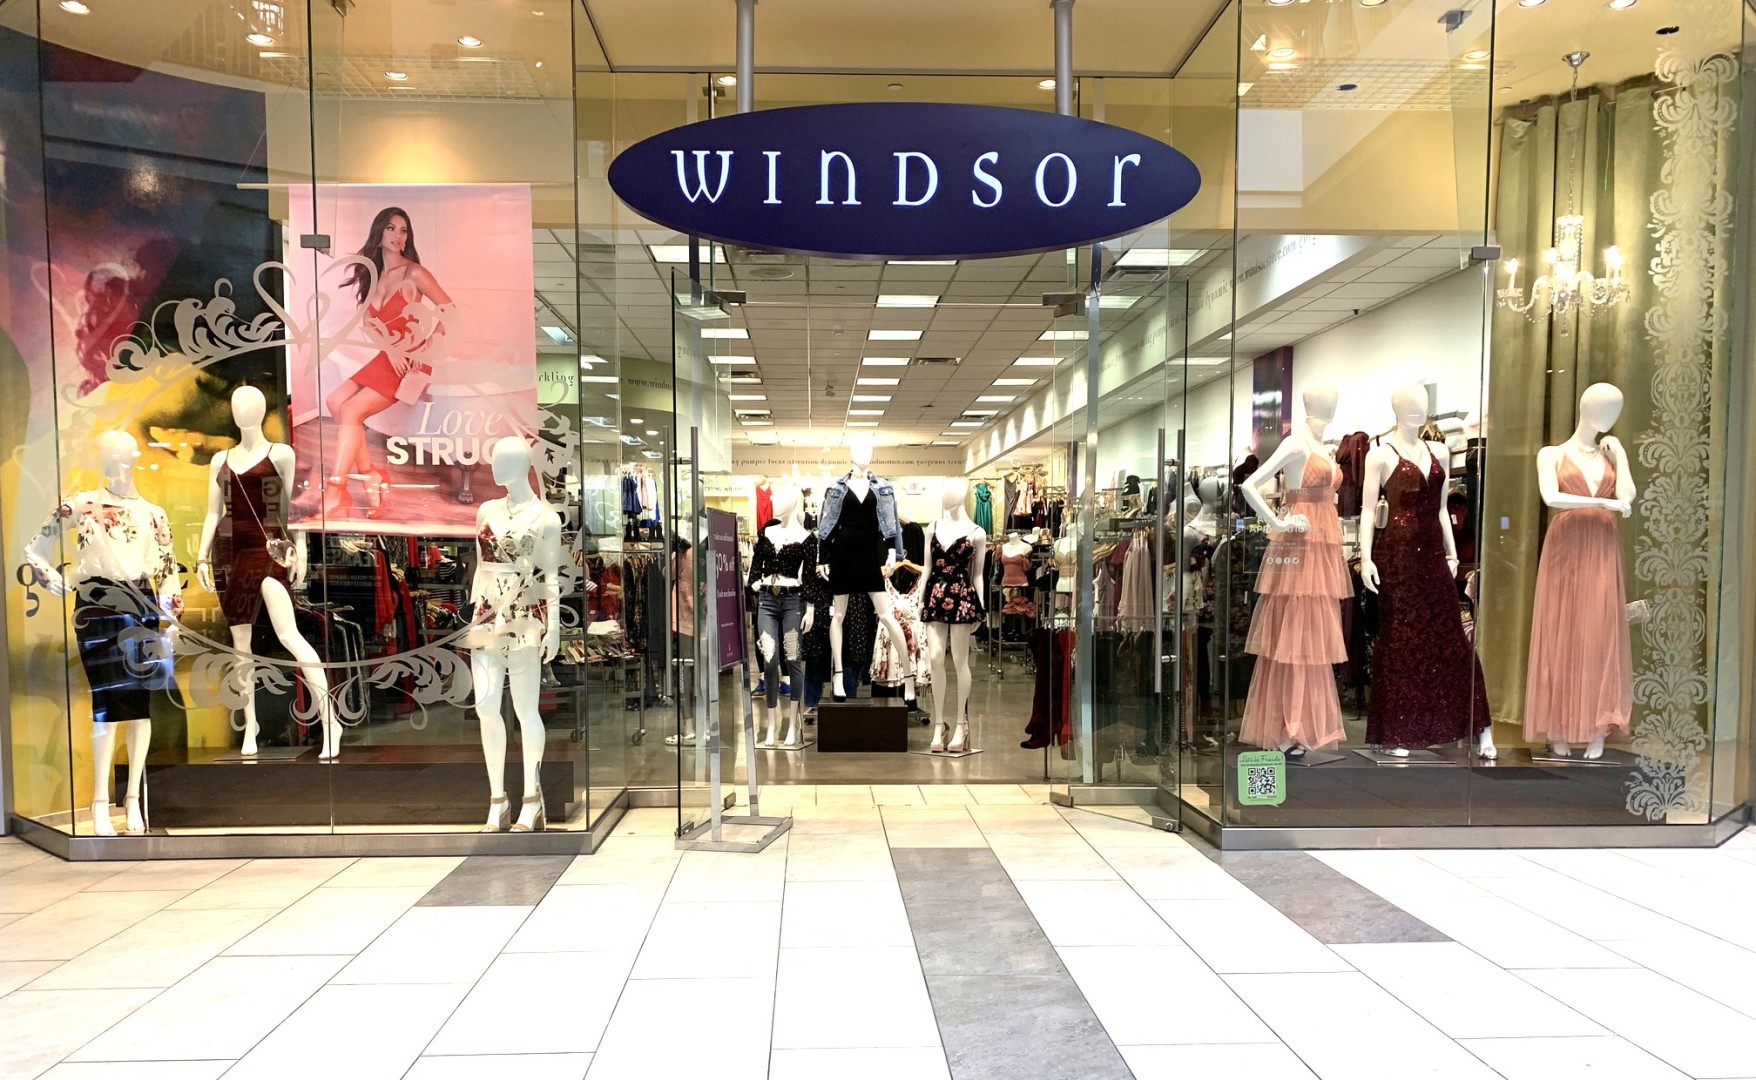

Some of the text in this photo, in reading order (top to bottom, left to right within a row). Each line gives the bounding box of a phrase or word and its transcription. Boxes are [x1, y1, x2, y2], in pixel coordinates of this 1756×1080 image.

[538, 371, 574, 387] rkling
[627, 378, 673, 390] www.windso
[416, 401, 502, 436] Love
[386, 436, 499, 466] STRUC
